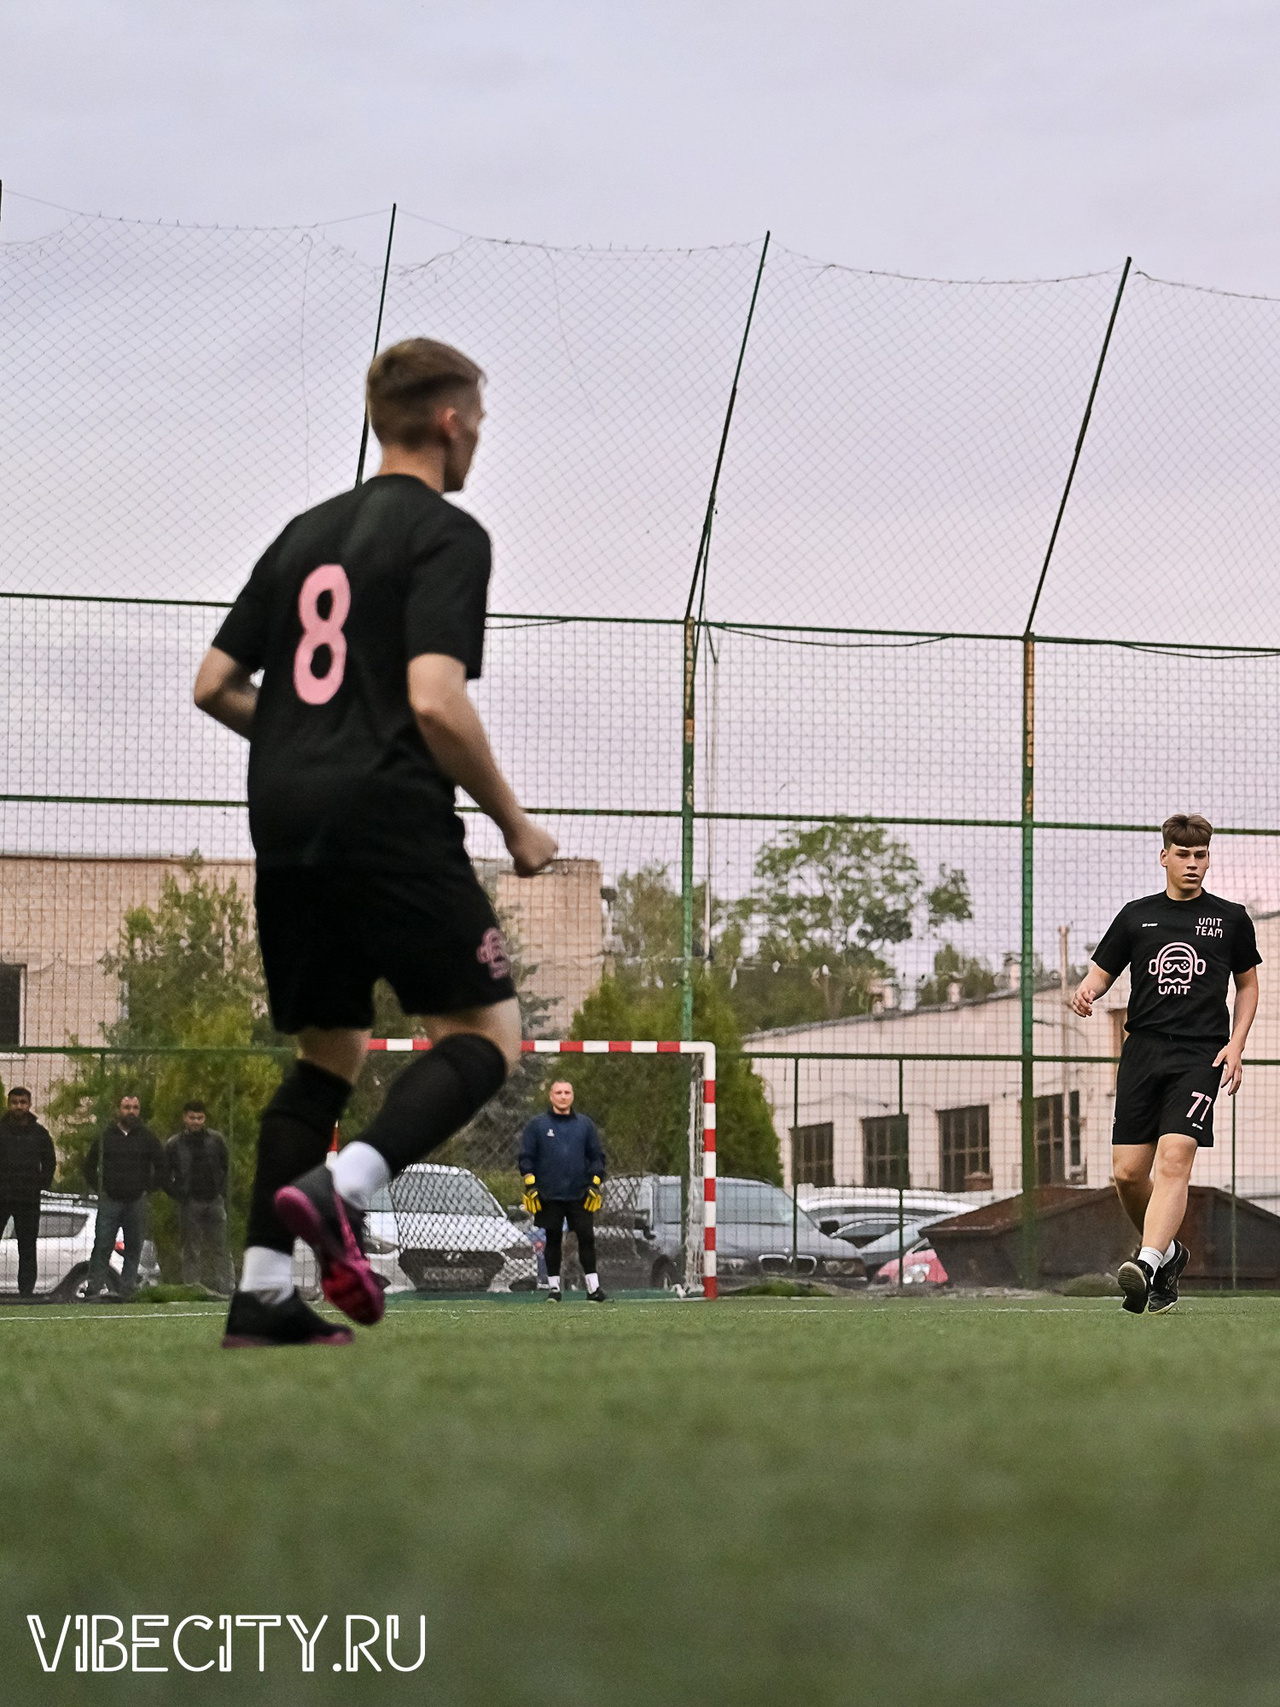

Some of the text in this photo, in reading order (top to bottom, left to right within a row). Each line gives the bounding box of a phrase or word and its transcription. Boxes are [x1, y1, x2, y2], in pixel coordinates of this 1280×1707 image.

[293, 564, 350, 705] 8
[1198, 917, 1223, 927] UNIT
[1195, 926, 1223, 938] TEAM
[1158, 985, 1191, 995] UNIT
[1186, 1091, 1213, 1122] 77
